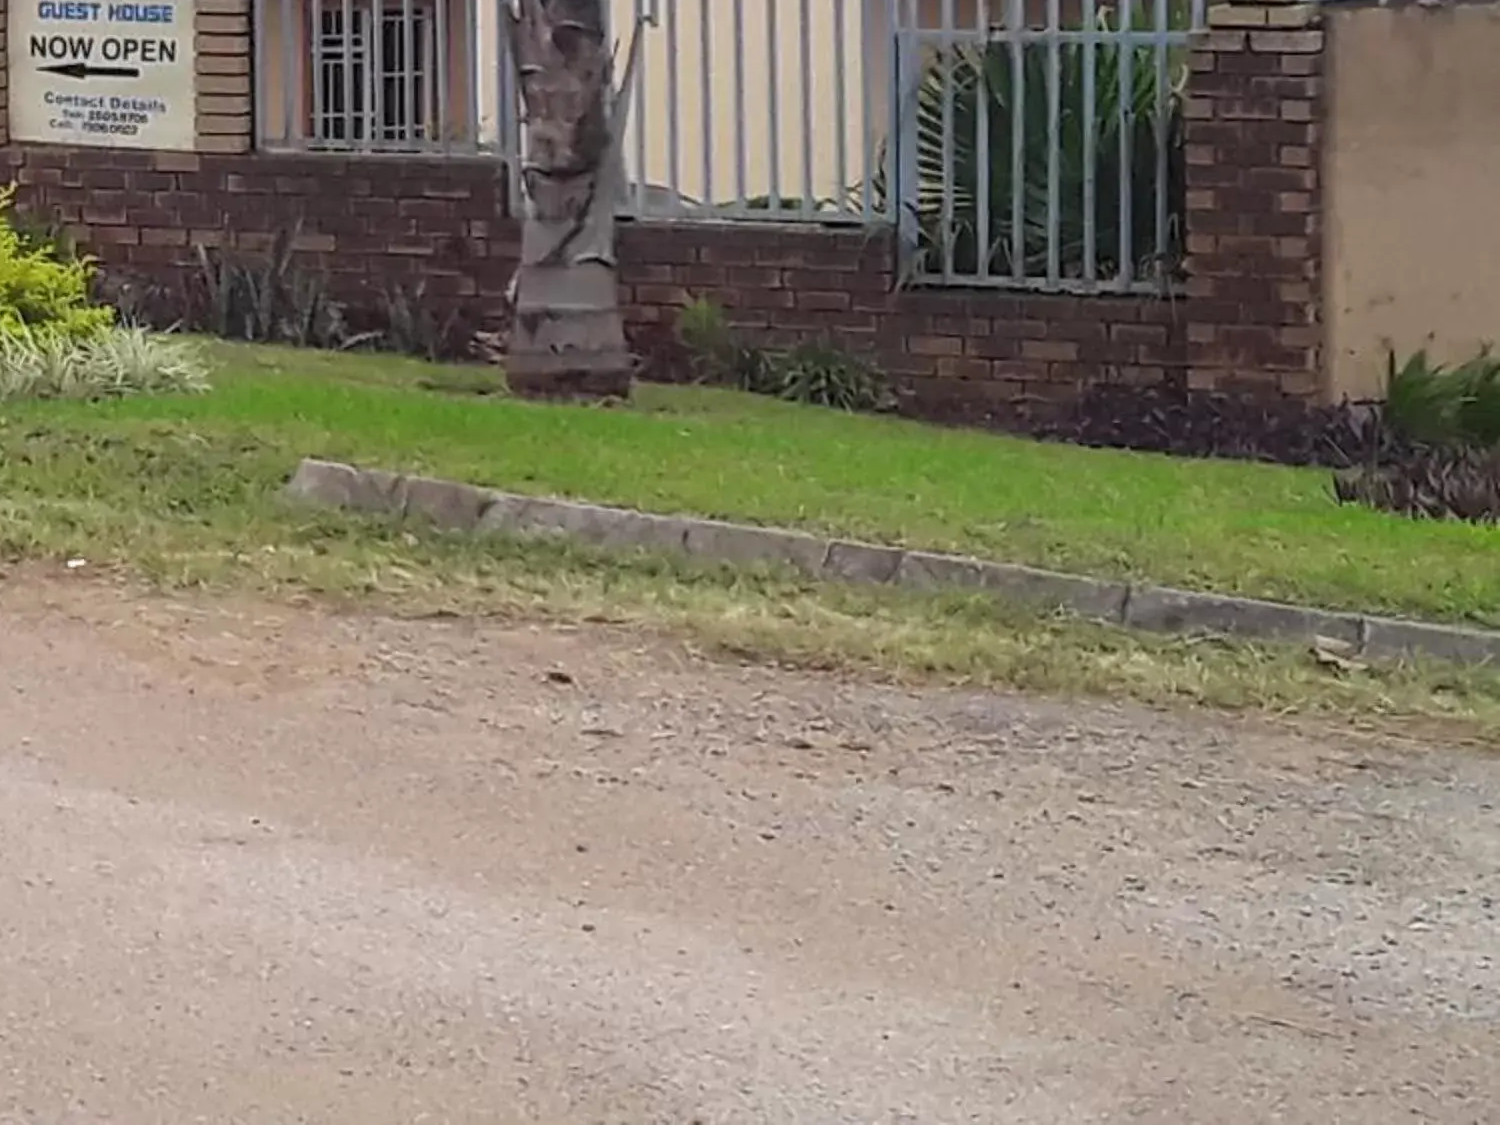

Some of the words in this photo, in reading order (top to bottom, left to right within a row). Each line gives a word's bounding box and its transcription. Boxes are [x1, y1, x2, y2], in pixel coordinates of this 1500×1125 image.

[38, 1, 101, 20] GUEST
[108, 3, 174, 23] HOUSE
[30, 35, 94, 60] NOW
[101, 38, 176, 63] OPEN
[43, 91, 104, 108] Contact
[109, 96, 167, 114] Details
